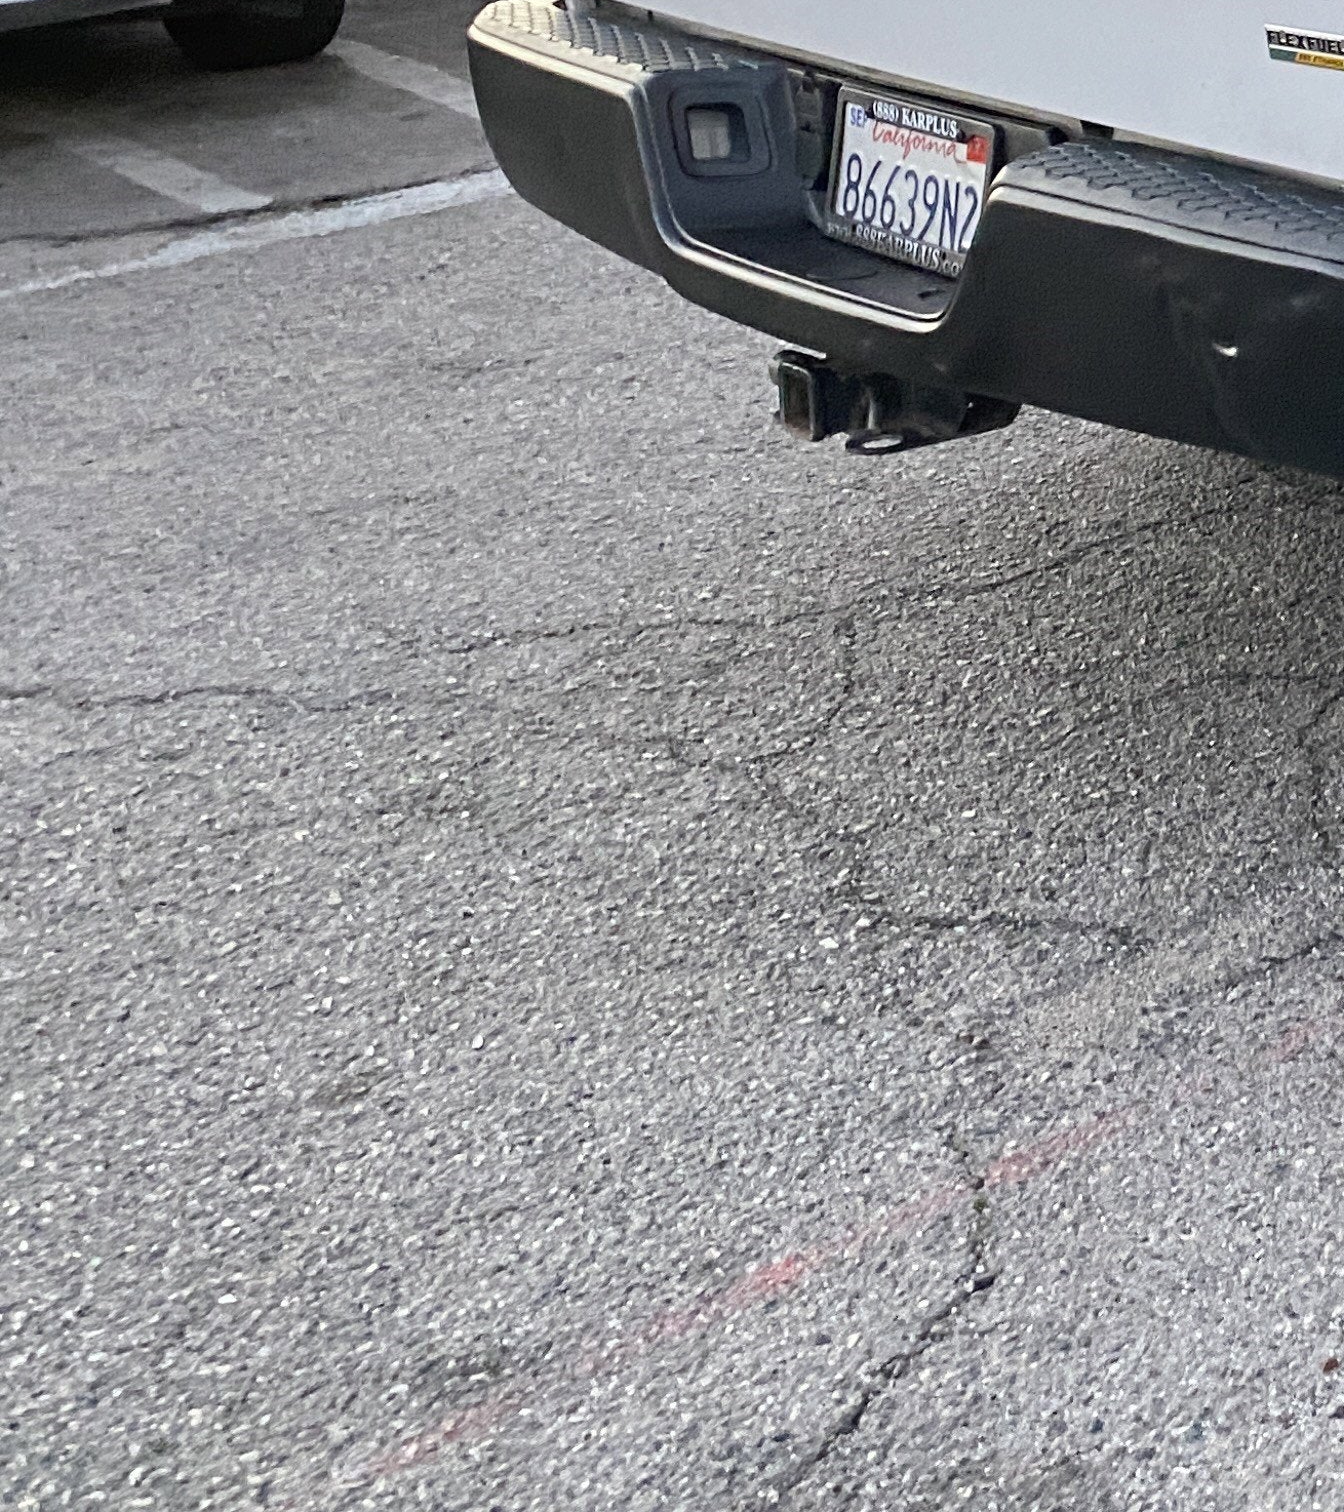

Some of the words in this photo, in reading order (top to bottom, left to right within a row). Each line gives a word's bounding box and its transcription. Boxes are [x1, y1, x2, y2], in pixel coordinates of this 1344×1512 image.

[872, 99, 899, 122] (888)
[901, 106, 959, 139] KARPLUS
[872, 120, 968, 164] California
[842, 152, 979, 255] 86639N2
